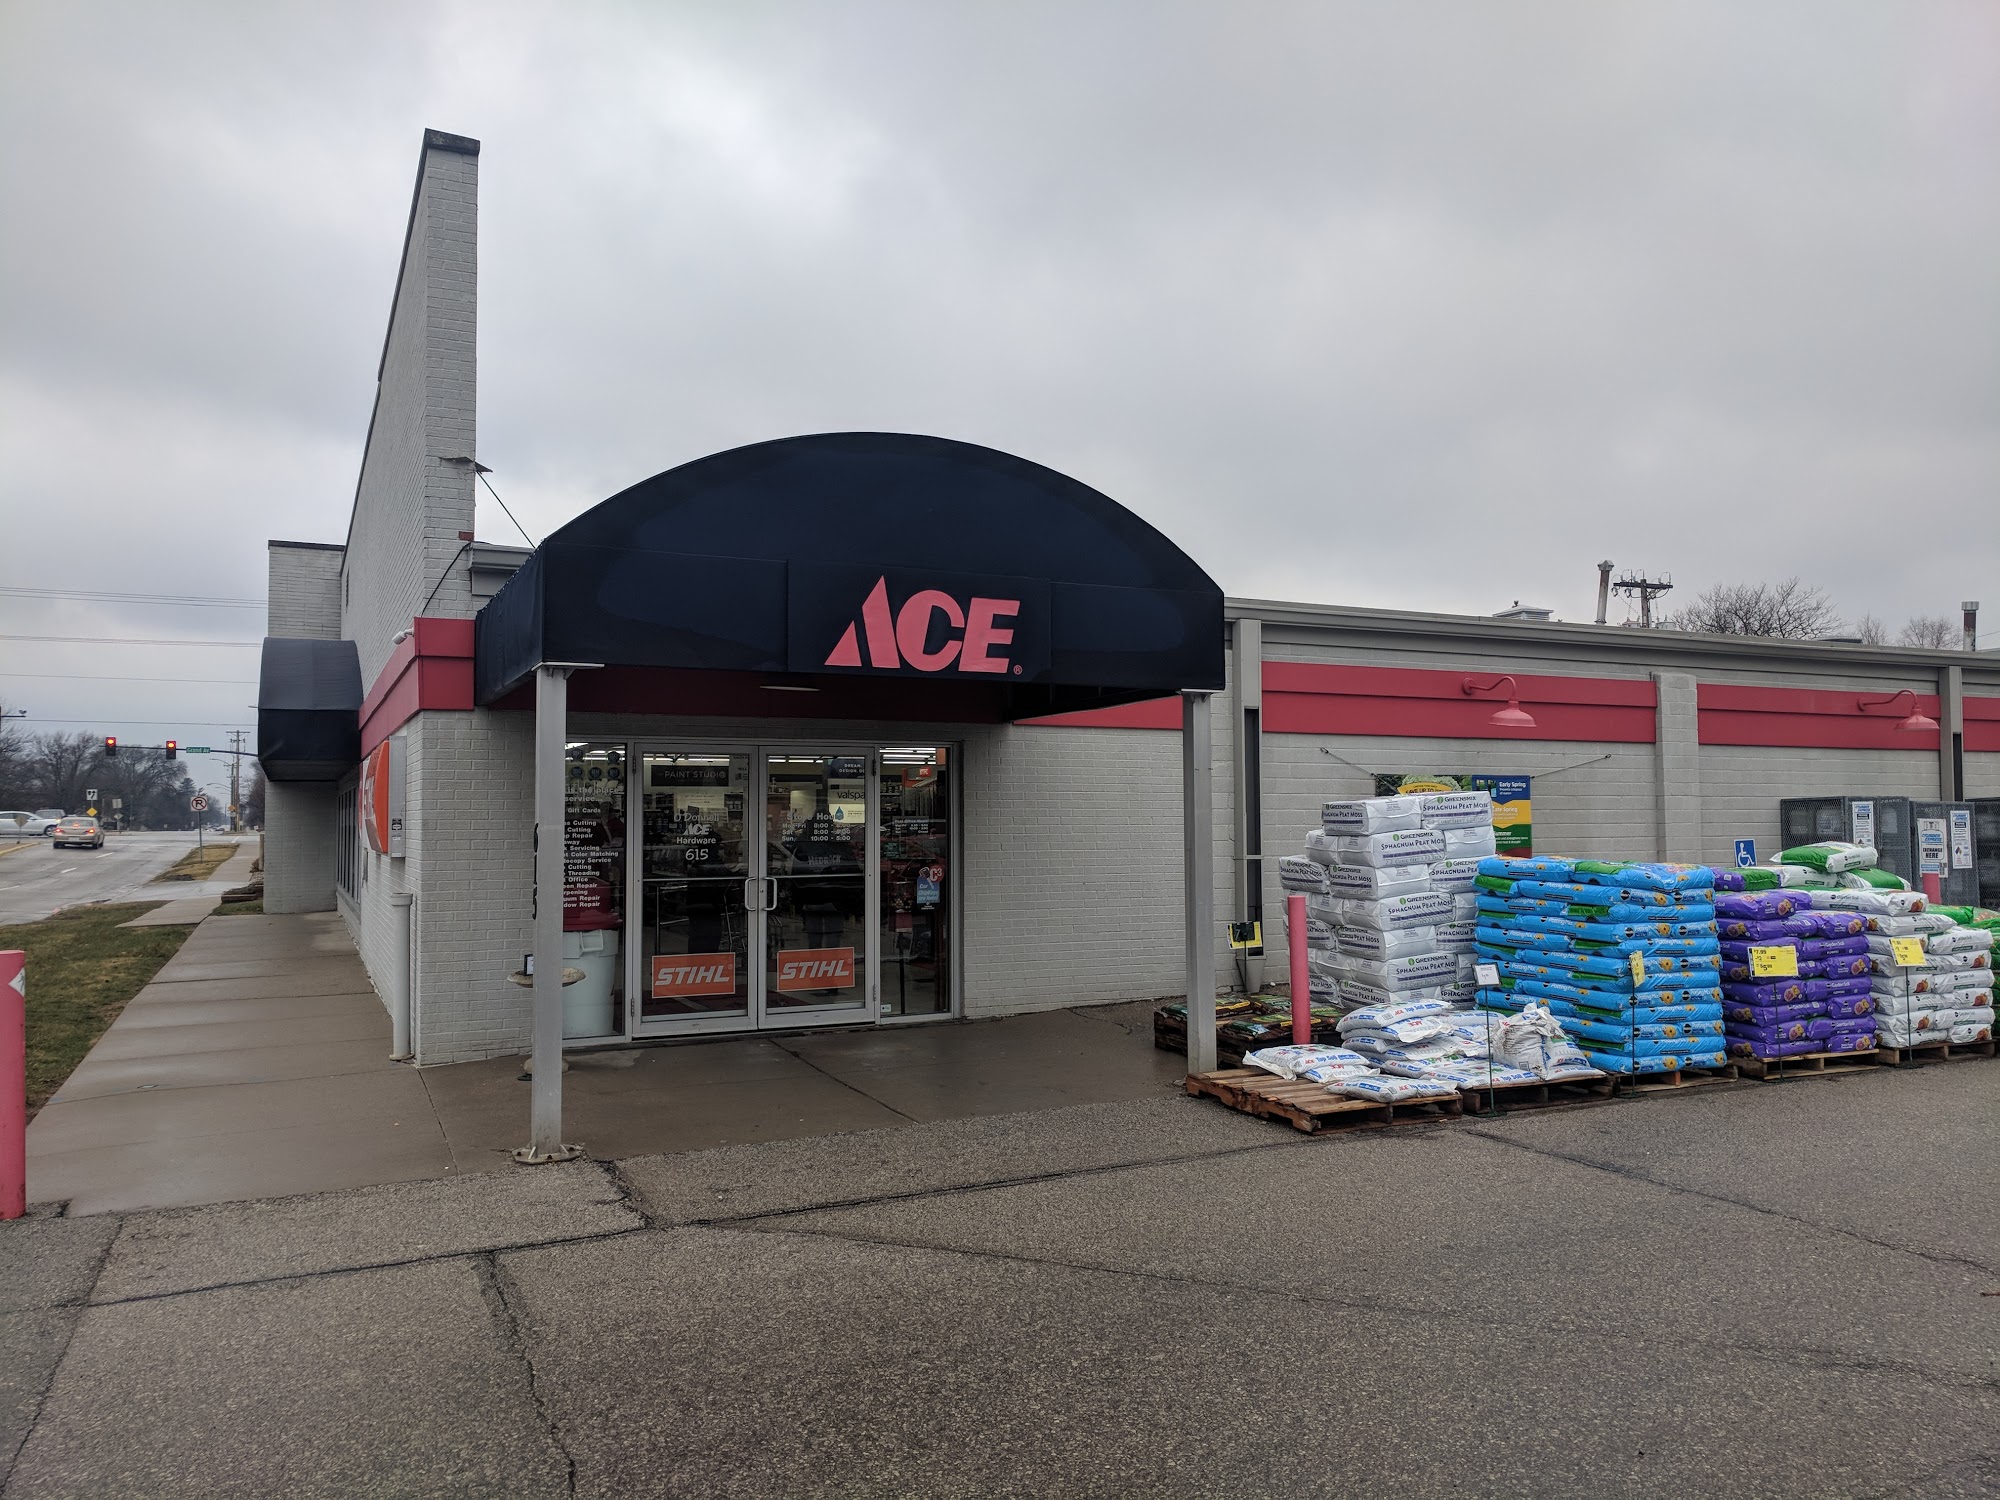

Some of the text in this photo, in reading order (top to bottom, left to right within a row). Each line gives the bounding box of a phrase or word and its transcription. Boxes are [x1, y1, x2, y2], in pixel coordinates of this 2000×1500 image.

[824, 574, 1020, 673] ACE
[683, 822, 711, 835] ACE
[1381, 840, 1414, 850] SPHAGNUM
[1415, 839, 1430, 847] PEAT
[685, 849, 709, 860] 615
[1431, 868, 1466, 876] SPHAGNUM
[1388, 904, 1421, 914] SPHAGNUM
[780, 960, 850, 980] STIHL
[1396, 965, 1430, 974] SPHAGNUM
[655, 965, 730, 986] STIHL
[1371, 994, 1385, 1003] MOSS
